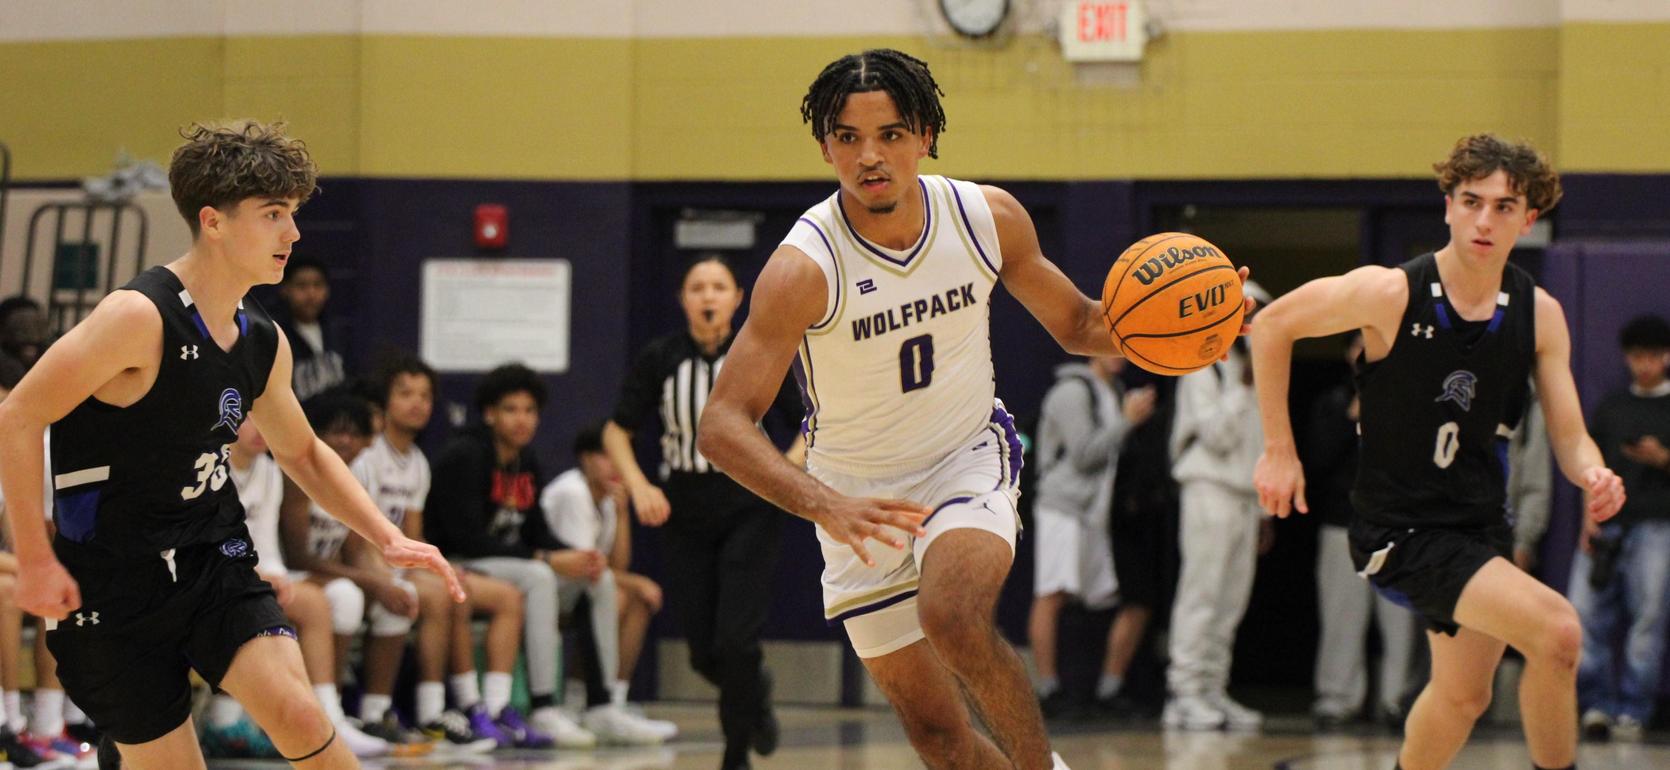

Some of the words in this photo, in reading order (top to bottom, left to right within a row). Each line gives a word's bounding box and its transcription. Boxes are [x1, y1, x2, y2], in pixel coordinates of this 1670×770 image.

[1077, 2, 1128, 42] EXIT
[1131, 245, 1222, 286] Wilson
[851, 281, 977, 342] WOLFPACK
[1178, 284, 1226, 319] EVO
[898, 332, 935, 394] 0
[1433, 421, 1460, 469] 0
